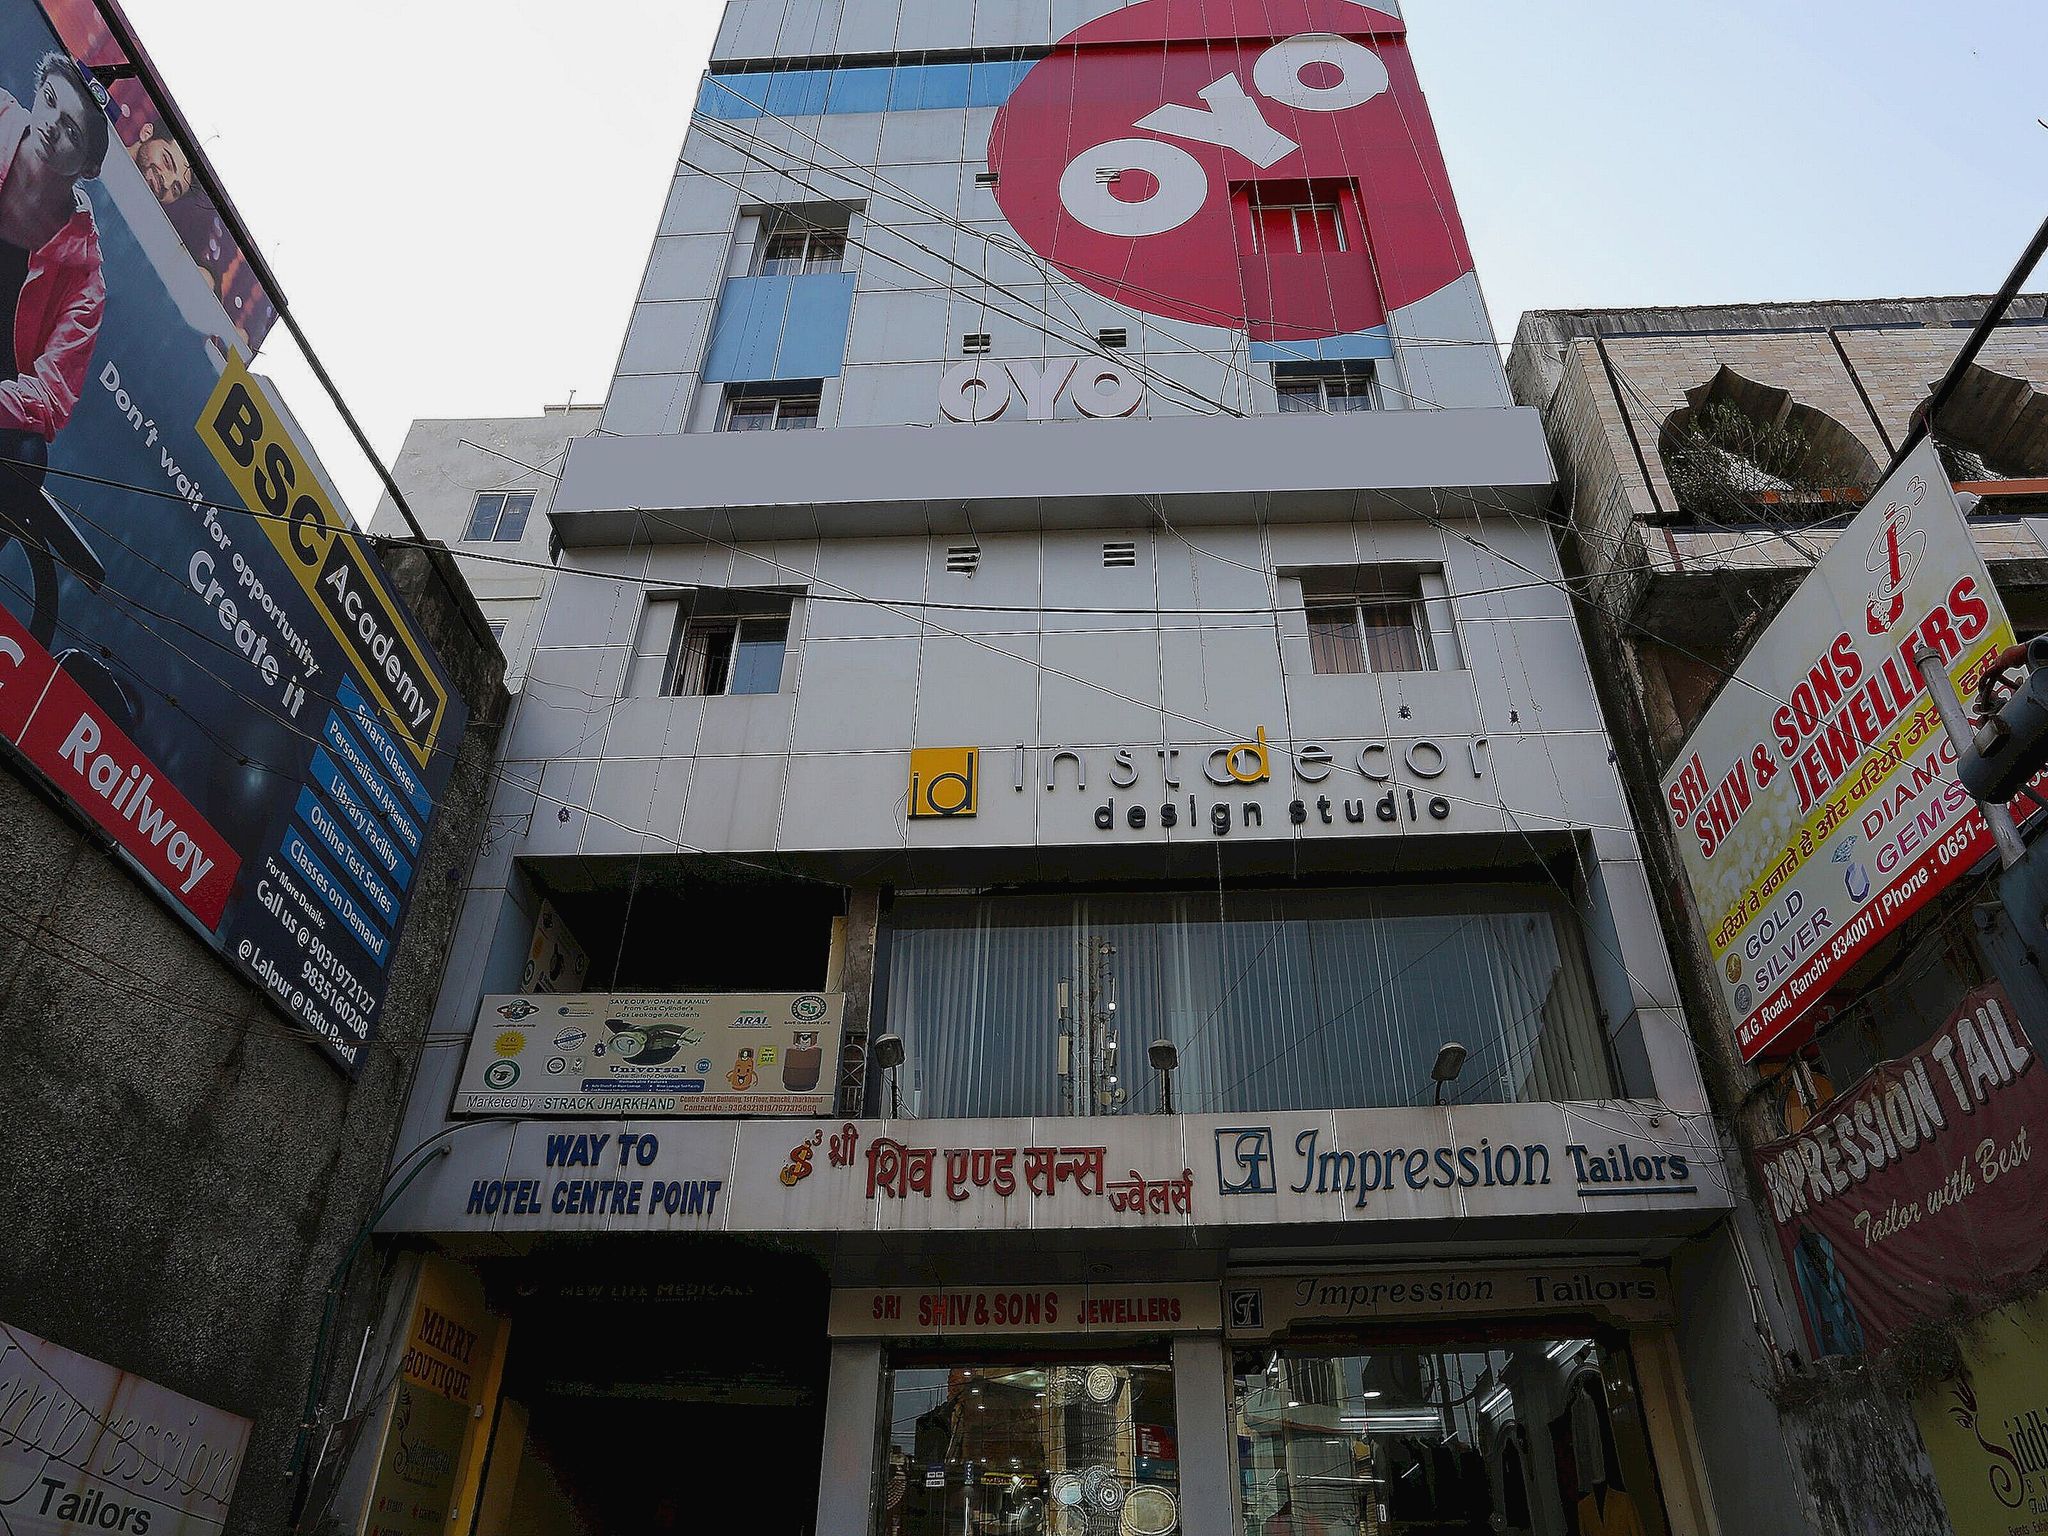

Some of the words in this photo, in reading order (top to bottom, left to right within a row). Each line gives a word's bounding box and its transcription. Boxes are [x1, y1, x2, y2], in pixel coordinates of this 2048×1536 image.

[1059, 32, 1389, 237] OYO
[938, 359, 1144, 423] OYO
[98, 361, 159, 447] Don't
[160, 446, 206, 513] wait
[202, 505, 233, 551] for
[232, 553, 324, 678] opportunity
[212, 383, 328, 567] BSC
[187, 549, 280, 688] Create
[280, 668, 305, 719] it
[325, 563, 432, 728] Academy
[1789, 575, 1991, 816] JEWELLERS
[329, 720, 383, 798] Personalized
[381, 794, 418, 848] Attention
[355, 703, 385, 752] Smart
[384, 744, 416, 795] Classes
[1667, 751, 1710, 830] SRI
[1693, 757, 1755, 860] SHIV
[1750, 742, 1779, 791] &
[1771, 631, 1864, 762] SONS
[57, 712, 215, 894] Railway
[330, 774, 366, 829] Library
[364, 818, 398, 872] Facility
[1093, 793, 1263, 836] design
[1288, 788, 1453, 826] studio
[1875, 778, 1968, 876] GEMS
[265, 855, 282, 878] For
[278, 871, 301, 901] More
[298, 892, 327, 930] Details:
[290, 838, 330, 898] Classes
[327, 886, 343, 911] on
[341, 899, 384, 957] Demand
[310, 805, 345, 858] Online
[344, 845, 365, 882] Test
[362, 869, 393, 915] Series
[256, 878, 285, 918] Call
[281, 910, 298, 935] us
[296, 926, 311, 948] @
[307, 935, 377, 1016] 9031972127
[1739, 1018, 1763, 1047] M.G.
[1761, 990, 1793, 1027] Road,
[1831, 910, 1877, 962] 834001
[1882, 866, 1930, 916] Phone
[1744, 889, 1805, 961] GOLD
[1753, 904, 1834, 995] SILVER
[238, 939, 253, 961] @
[250, 946, 294, 1000] Lalpur
[291, 990, 305, 1011] @
[302, 998, 330, 1036] Ratu
[327, 1023, 359, 1066] Road
[300, 959, 369, 1041] 9835160208
[466, 1095, 518, 1109] Marketed
[519, 1095, 536, 1111] by
[543, 1096, 596, 1111] STRACK
[597, 1096, 676, 1111] JHARKHAND
[609, 1065, 688, 1074] Universal
[546, 1134, 611, 1168] WAY
[618, 1132, 660, 1168] TO
[865, 1136, 937, 1200] शिव
[1022, 1145, 1107, 1196] सन्स
[1290, 1126, 1552, 1208] Impression
[1565, 1139, 1691, 1184] Tailors
[1853, 1199, 1922, 1249] Tailor
[1926, 1155, 1976, 1215] with
[1974, 1125, 2032, 1184] Best
[466, 1180, 544, 1215] HOTEL
[551, 1180, 645, 1215] CENTRE
[648, 1180, 723, 1216] POINT
[417, 1304, 479, 1366] MARRY
[872, 1295, 901, 1320] SRI
[1077, 1296, 1181, 1324] JEWELLERS
[1294, 1274, 1494, 1316] Impression
[1527, 1273, 1658, 1304] Tailors
[404, 1345, 473, 1401] BOUTIQUE
[38, 1477, 152, 1536] Tailors
